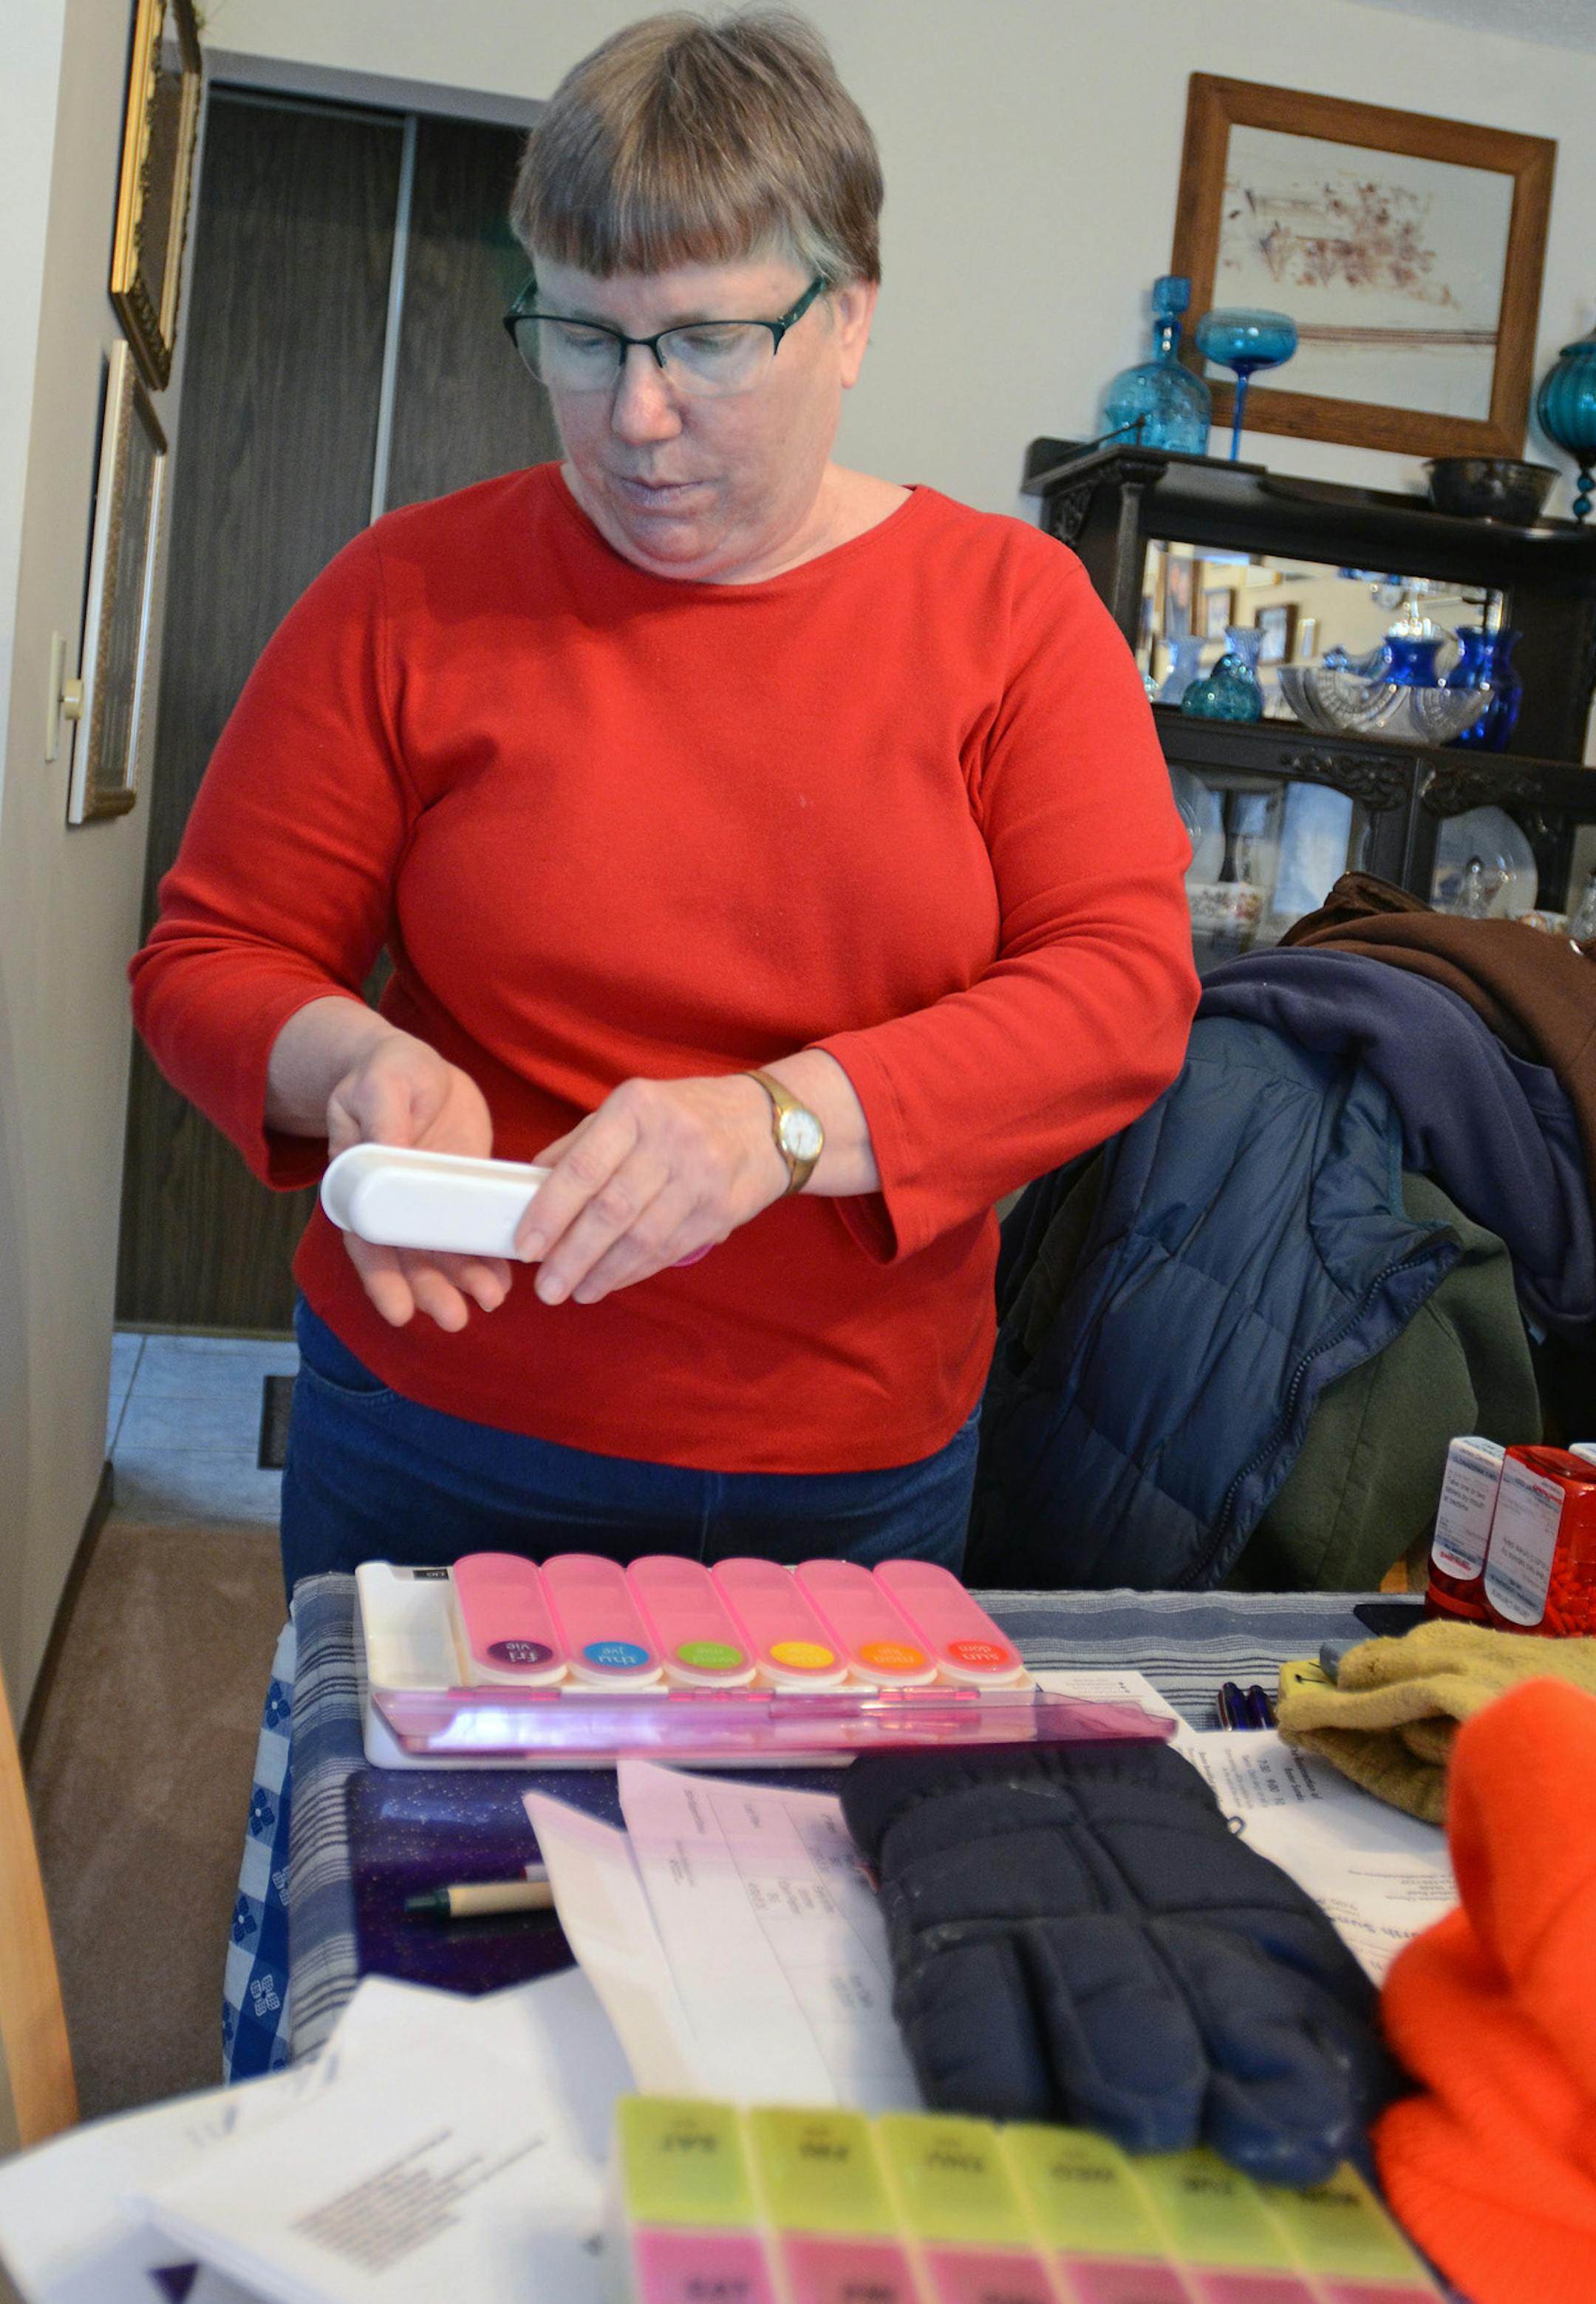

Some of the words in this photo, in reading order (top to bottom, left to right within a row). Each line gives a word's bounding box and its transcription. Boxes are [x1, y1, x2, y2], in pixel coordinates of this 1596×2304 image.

[506, 1641, 531, 1652] vie
[958, 1645, 992, 1654] dom
[508, 1650, 539, 1663] fri
[597, 1654, 637, 1666] thu
[962, 1653, 1000, 1662] sun
